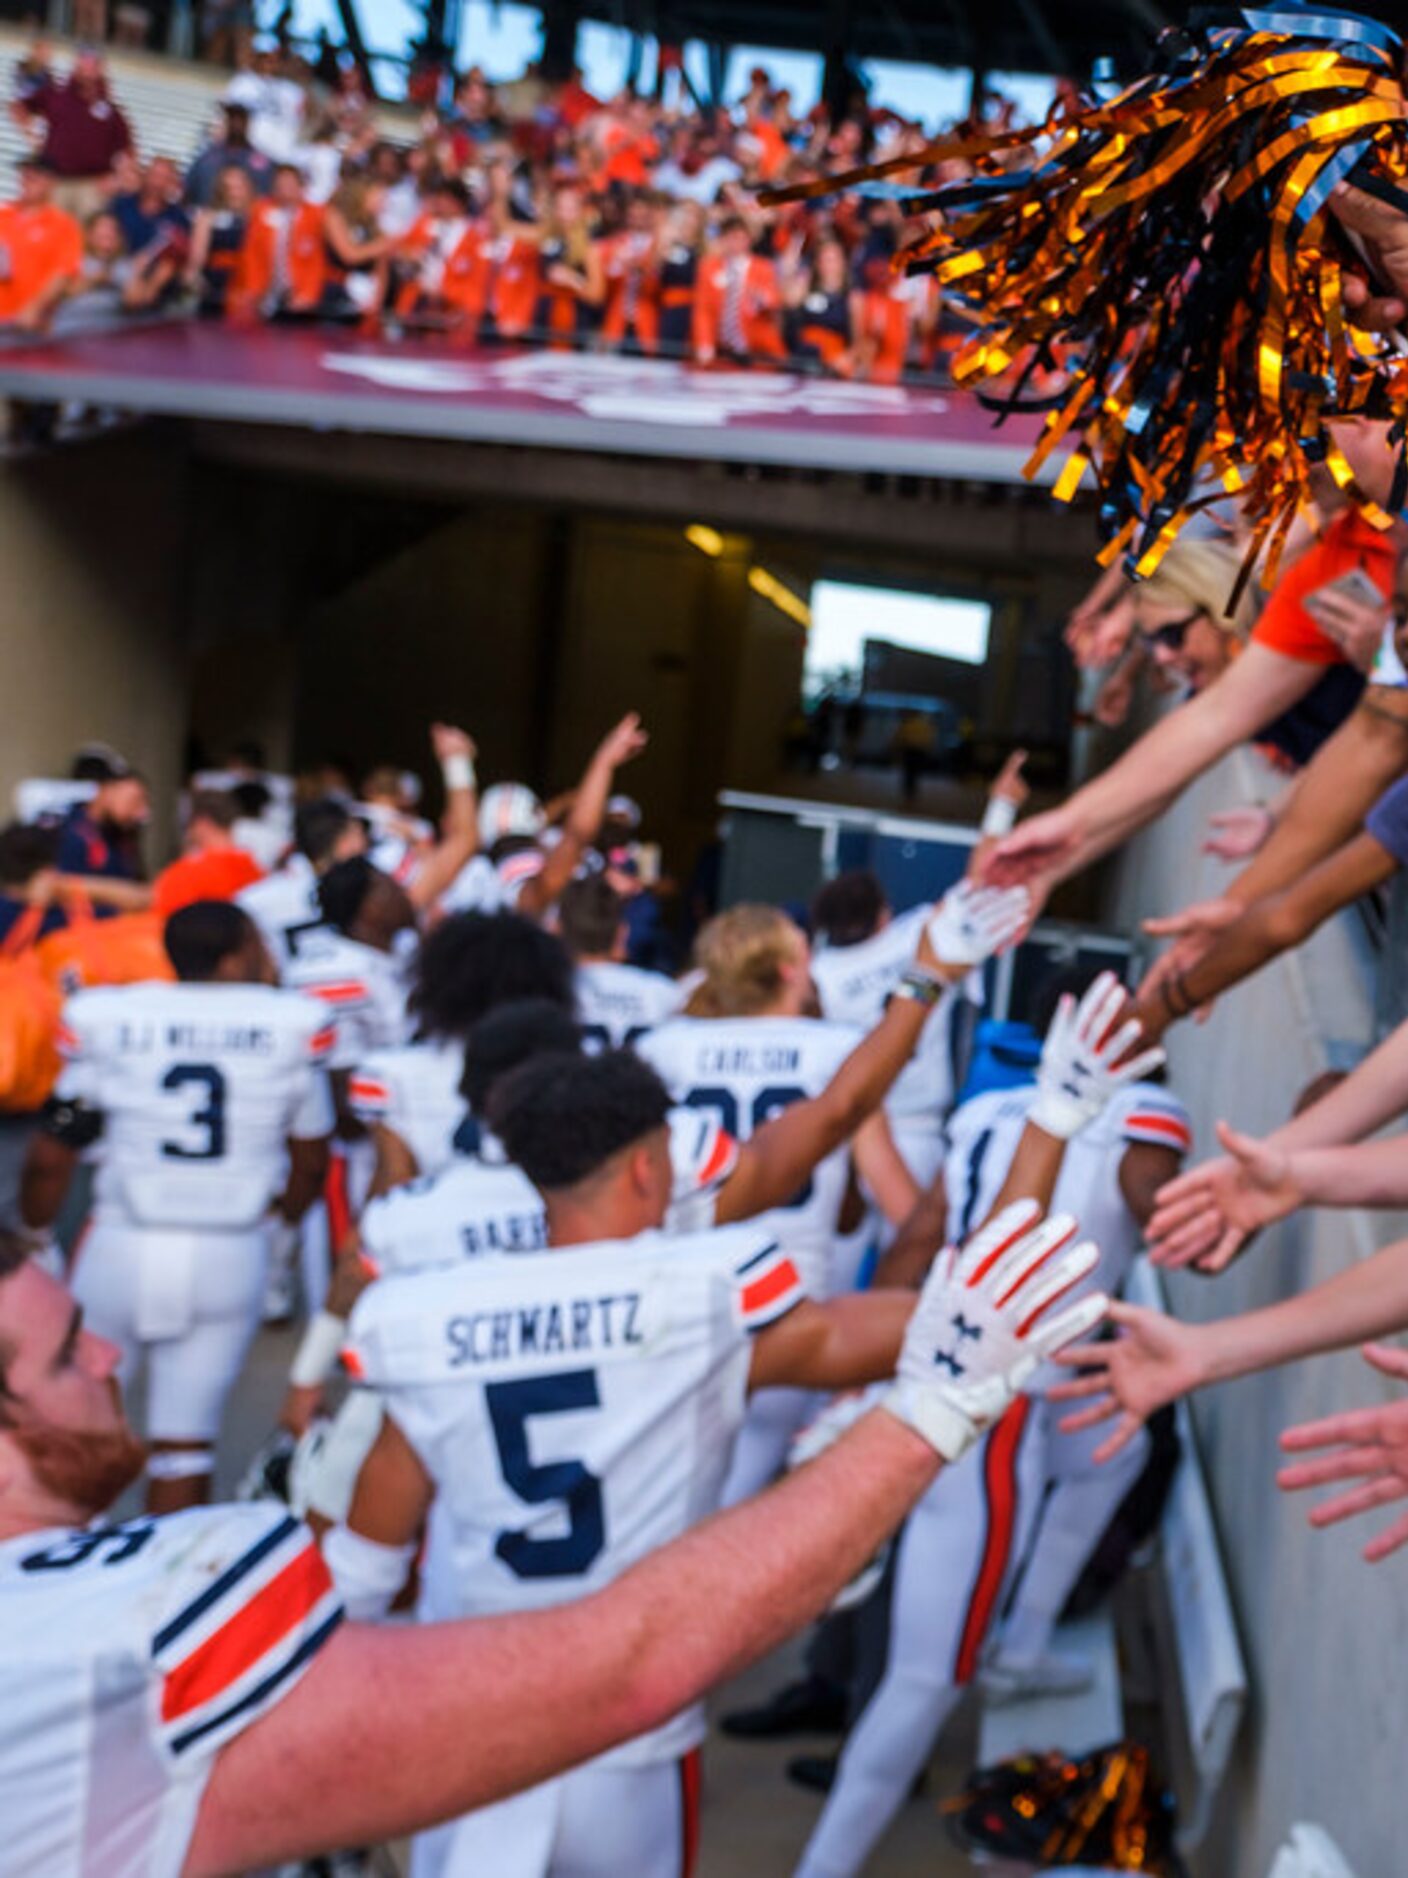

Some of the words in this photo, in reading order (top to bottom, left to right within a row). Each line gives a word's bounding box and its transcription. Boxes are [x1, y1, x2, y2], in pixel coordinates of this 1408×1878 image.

[700, 1047, 804, 1076] CARLSON
[162, 1063, 227, 1160] 3
[446, 1293, 643, 1368] SCHWARTZ
[484, 1366, 606, 1580] 5
